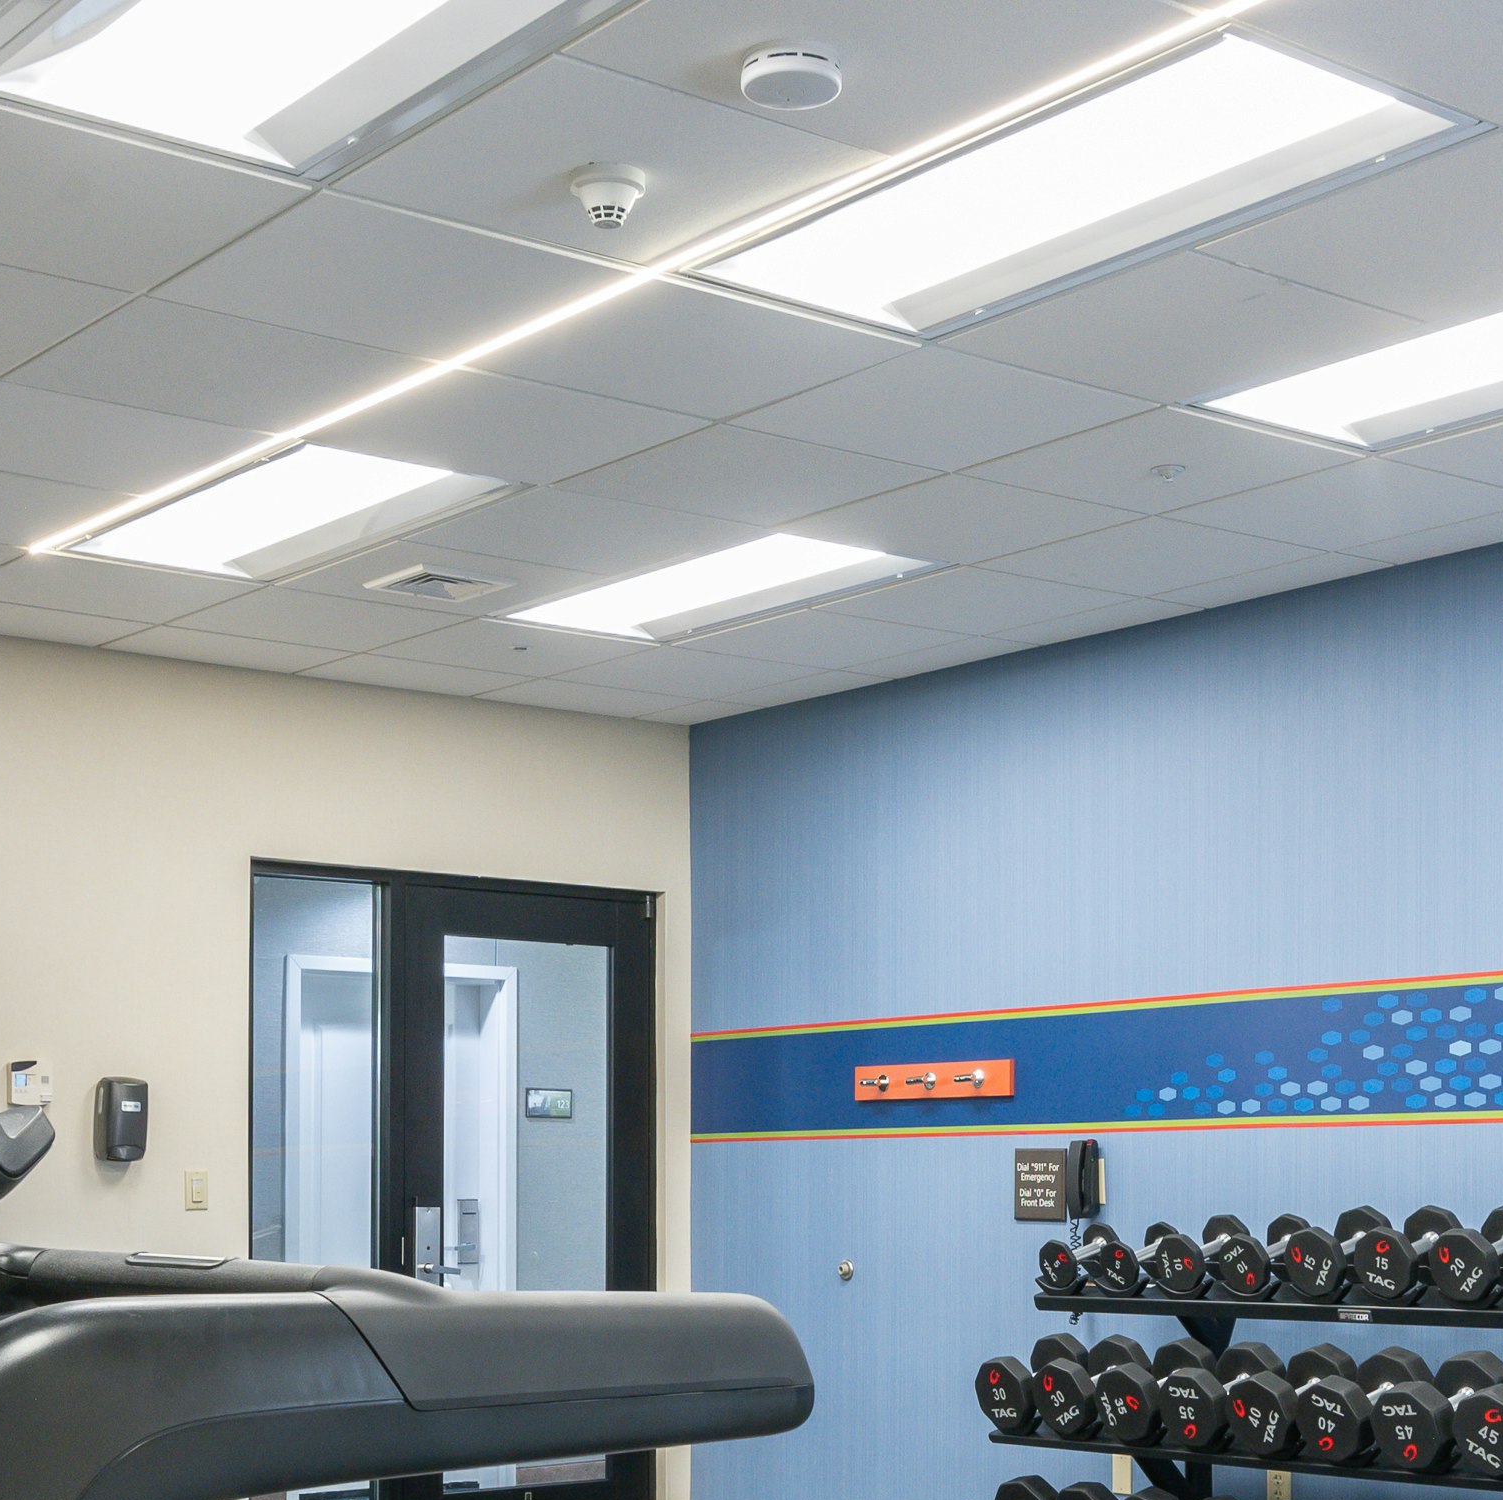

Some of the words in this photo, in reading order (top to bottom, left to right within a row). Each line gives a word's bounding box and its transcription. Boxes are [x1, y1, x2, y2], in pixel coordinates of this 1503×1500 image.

[557, 1100, 570, 1109] 123
[1017, 1162, 1029, 1171] Dial
[1031, 1163, 1046, 1171] "911"
[1049, 1163, 1059, 1171] For
[1021, 1172, 1055, 1183] Emergency
[1019, 1188, 1032, 1197] Dial
[1034, 1188, 1044, 1197] "0"
[1046, 1189, 1057, 1197] For
[1021, 1198, 1037, 1207] Front
[1039, 1198, 1055, 1207] Desk
[1224, 1245, 1244, 1262] TAG
[1043, 1260, 1058, 1281] TAG
[1115, 1261, 1120, 1269] 5
[1162, 1250, 1173, 1279] TAG
[1173, 1257, 1182, 1270] 10
[1237, 1261, 1248, 1274] 10
[1303, 1255, 1316, 1271] 15
[1375, 1256, 1389, 1270] 15
[1450, 1258, 1465, 1277] 20
[1106, 1268, 1125, 1285] TAG
[1316, 1257, 1332, 1286] TAG
[1460, 1266, 1483, 1293] TAG
[1365, 1272, 1395, 1290] TAG
[993, 1388, 1006, 1400] 30
[1051, 1391, 1065, 1407] 30
[1168, 1386, 1199, 1399] TAG
[991, 1408, 1016, 1418] TAG
[1101, 1392, 1117, 1426] TAG
[1115, 1398, 1128, 1415] 35
[1179, 1406, 1195, 1420] 35
[1311, 1394, 1344, 1417] TAG
[1382, 1405, 1417, 1416] TAG
[1056, 1406, 1079, 1426] TAG
[1248, 1408, 1262, 1428] 40
[1263, 1411, 1279, 1443] TAG
[1318, 1417, 1335, 1433] 40
[1395, 1425, 1413, 1439] 45
[1478, 1426, 1500, 1445] 45
[1466, 1439, 1501, 1469] TAG
